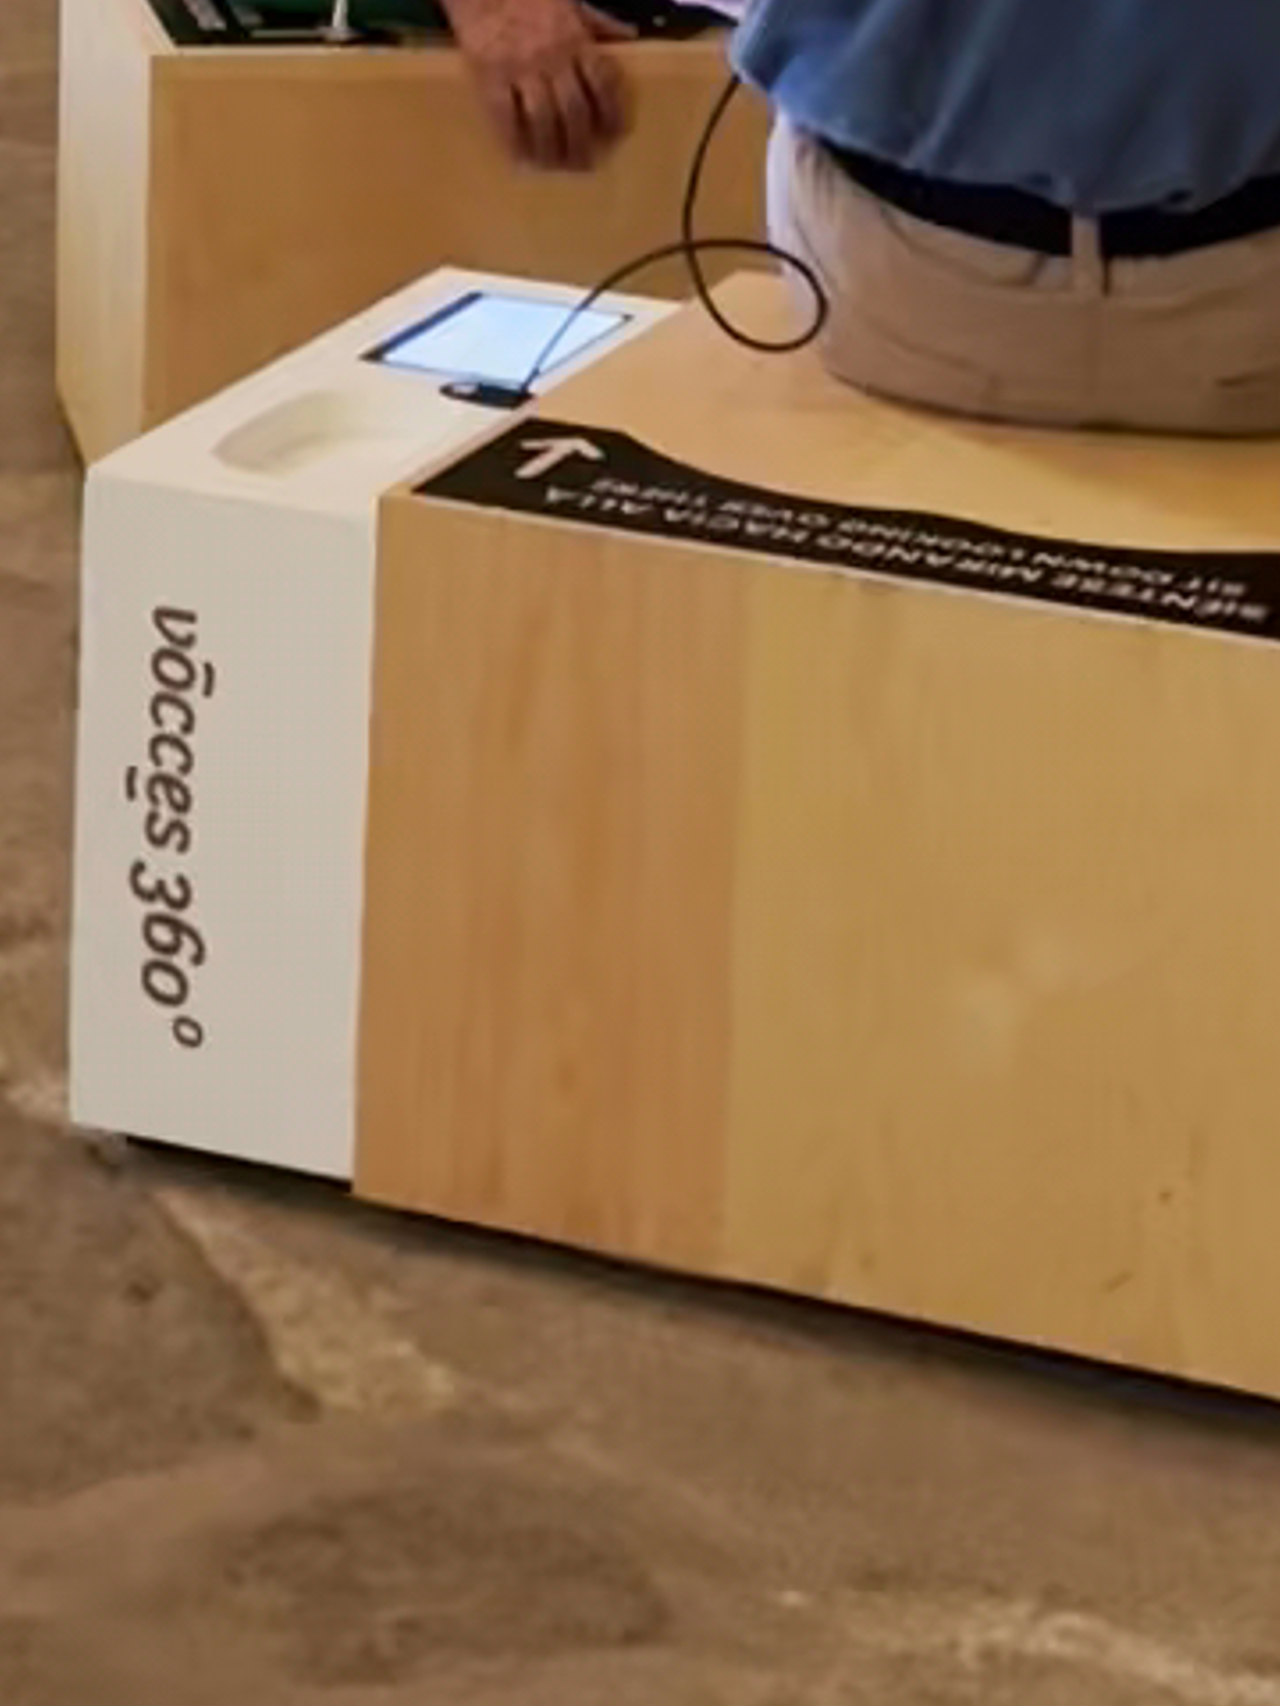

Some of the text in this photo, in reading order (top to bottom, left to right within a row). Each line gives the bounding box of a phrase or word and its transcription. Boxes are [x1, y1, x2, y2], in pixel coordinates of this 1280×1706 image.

[663, 506, 810, 545] HACIA
[719, 499, 830, 528] OVER
[817, 533, 1044, 583] MIRANDO
[837, 519, 1025, 561] LOOKING
[1031, 550, 1174, 586] DOWN
[1183, 577, 1247, 597] SIT
